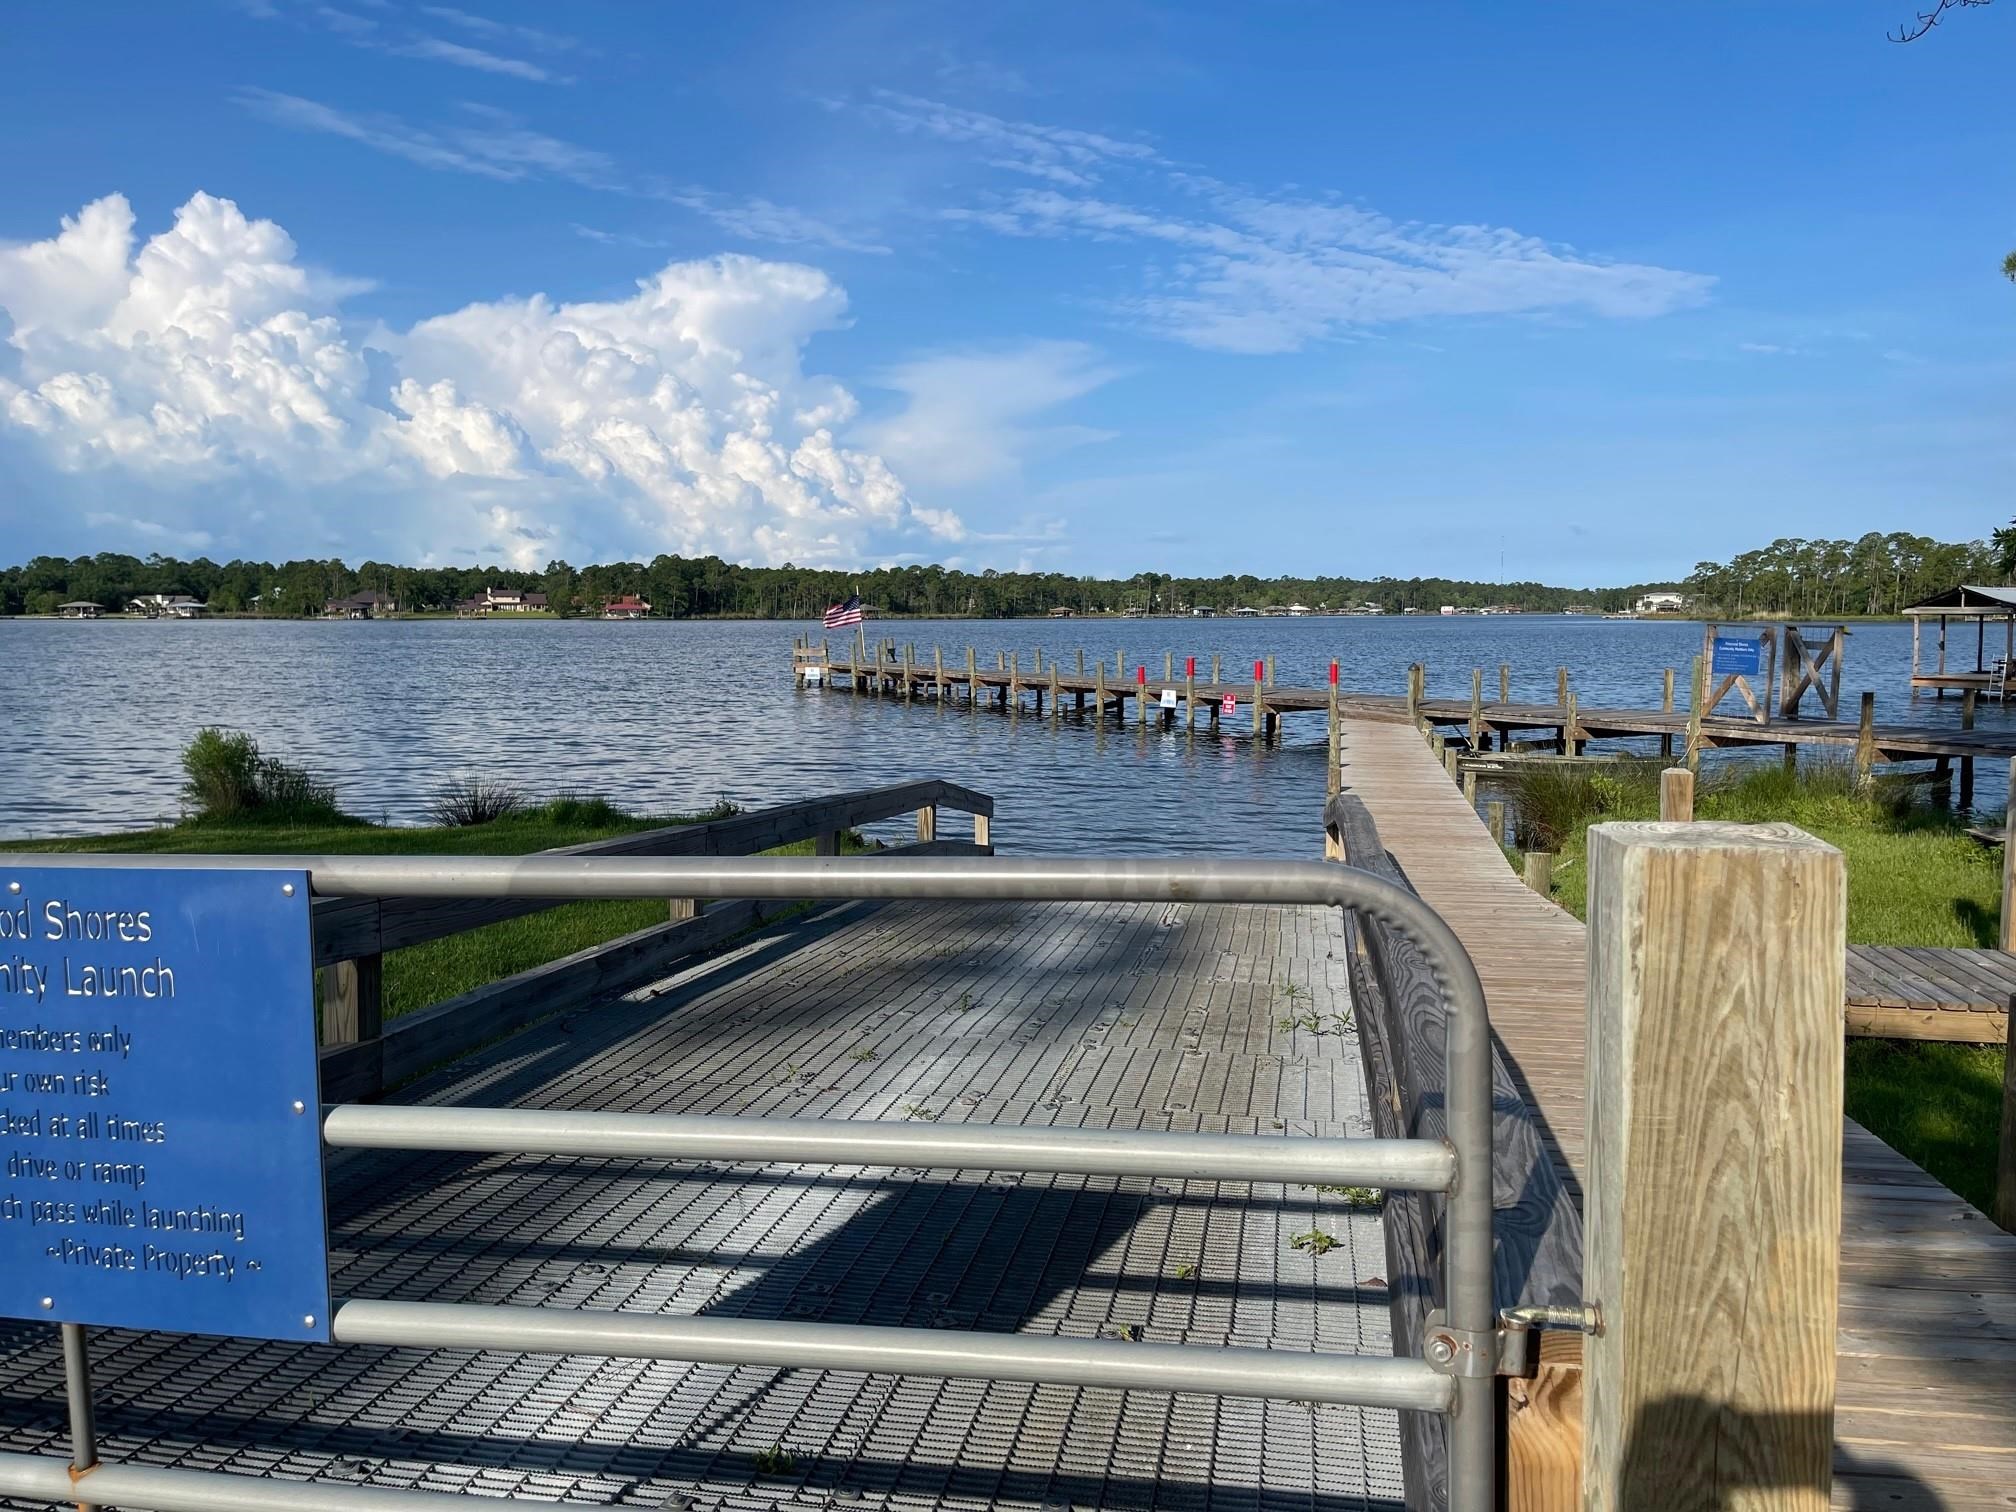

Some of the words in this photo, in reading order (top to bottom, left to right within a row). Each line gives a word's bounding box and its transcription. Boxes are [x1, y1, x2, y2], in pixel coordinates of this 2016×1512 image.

[44, 900, 152, 942] Shores
[64, 956, 175, 998] Launch
[0, 1023, 81, 1053] embers
[88, 1024, 131, 1060] only
[24, 1072, 65, 1094] own
[73, 1069, 110, 1097] risk
[49, 1112, 70, 1138] at
[76, 1111, 99, 1140] all
[107, 1113, 166, 1143] times
[7, 1151, 58, 1180] drive
[64, 1159, 86, 1181] or
[93, 1162, 146, 1191] ramp
[31, 1200, 76, 1226] pass
[82, 1199, 136, 1228] while
[142, 1200, 245, 1241] launching
[143, 1243, 236, 1283] Property
